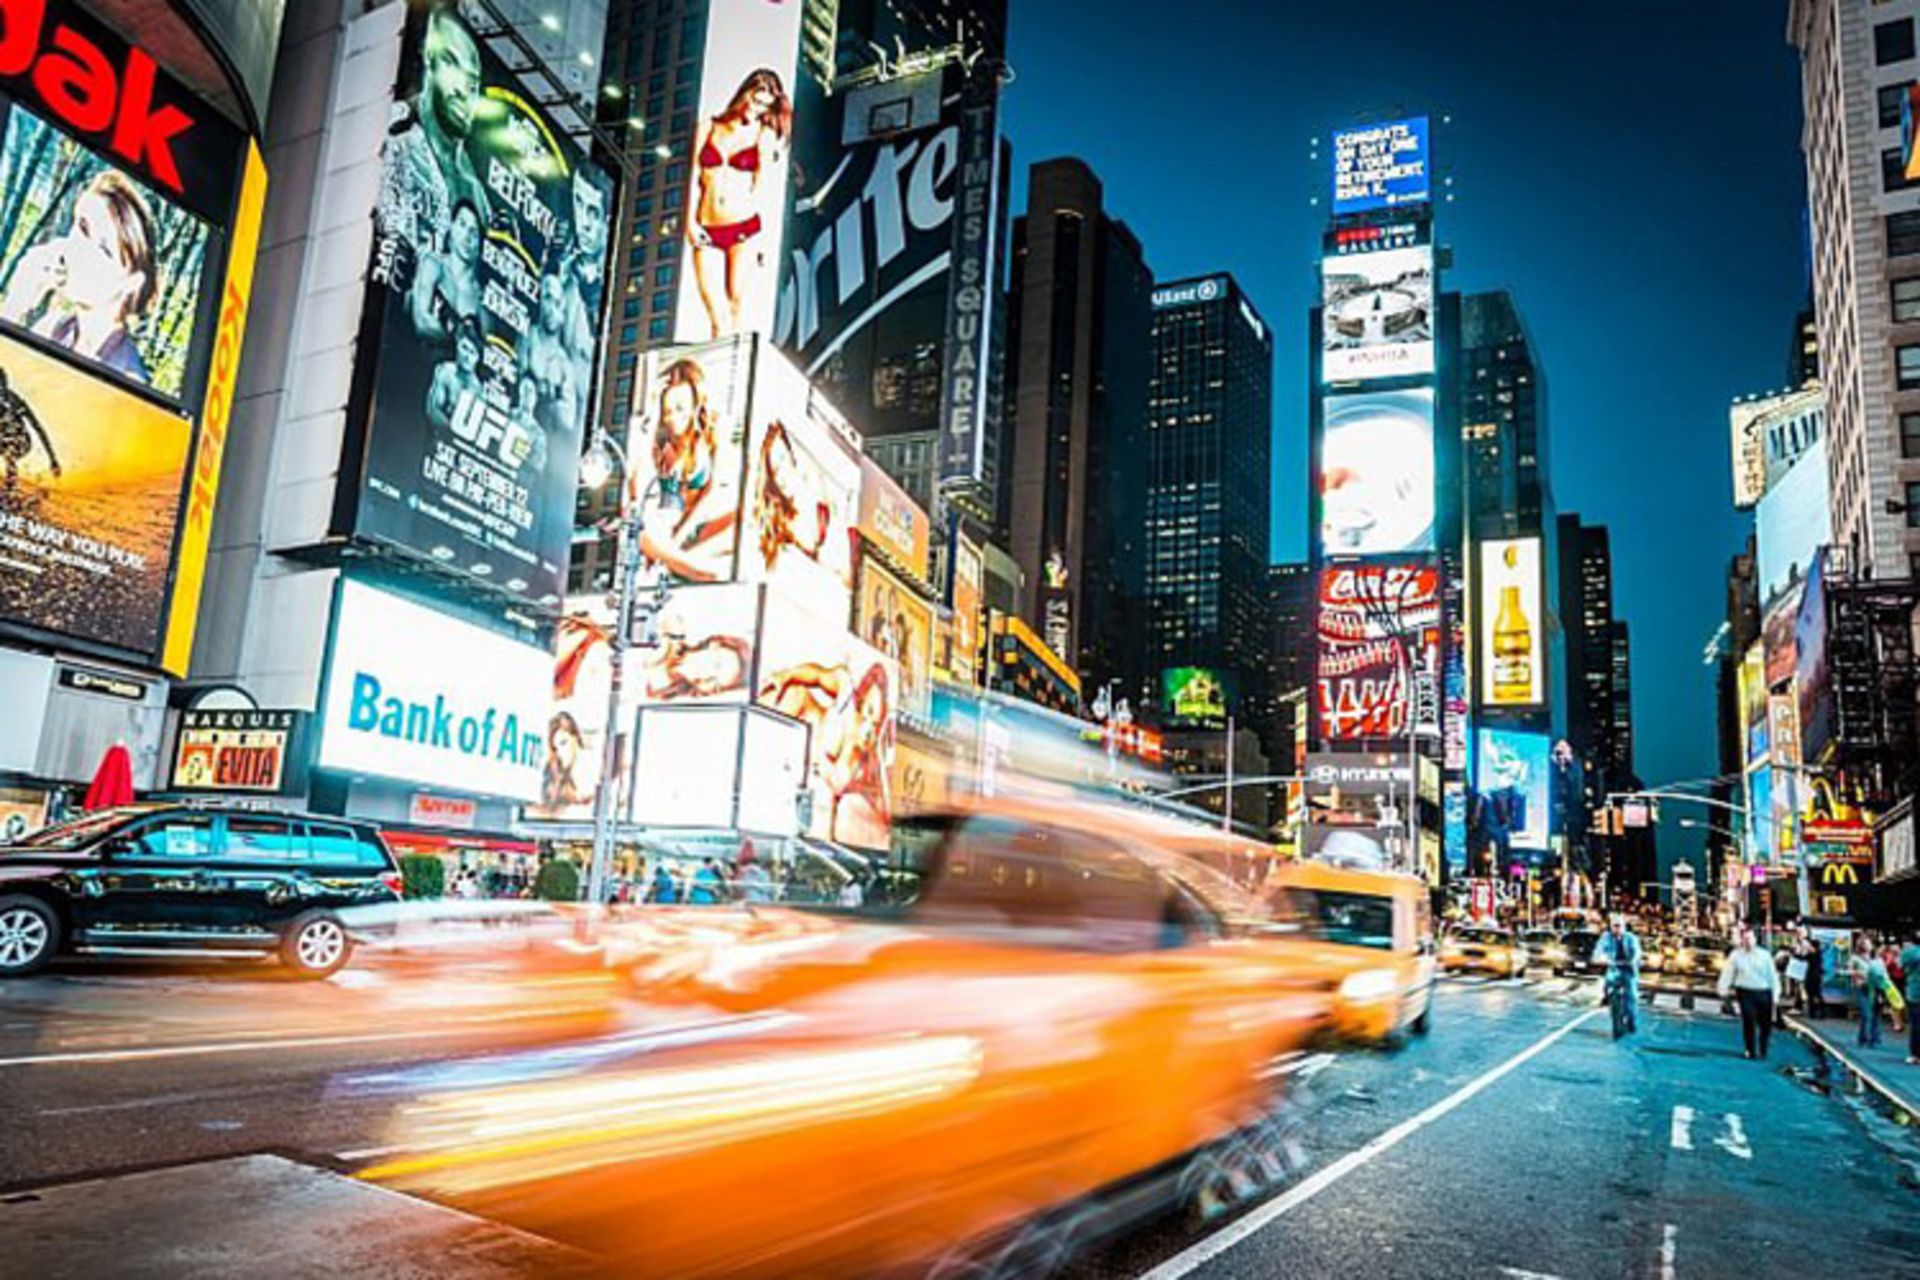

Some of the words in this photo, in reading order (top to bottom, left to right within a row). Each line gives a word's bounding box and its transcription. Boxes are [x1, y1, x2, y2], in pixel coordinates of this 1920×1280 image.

[960, 106, 989, 242] TIMES
[949, 257, 984, 436] SQUARE
[450, 390, 532, 470] UFC
[27, 519, 68, 547] WAY
[69, 534, 106, 559] YOU
[184, 712, 293, 727] MARQUIS
[347, 671, 455, 749] Bank
[458, 707, 496, 757] of
[215, 746, 275, 786] EVITA
